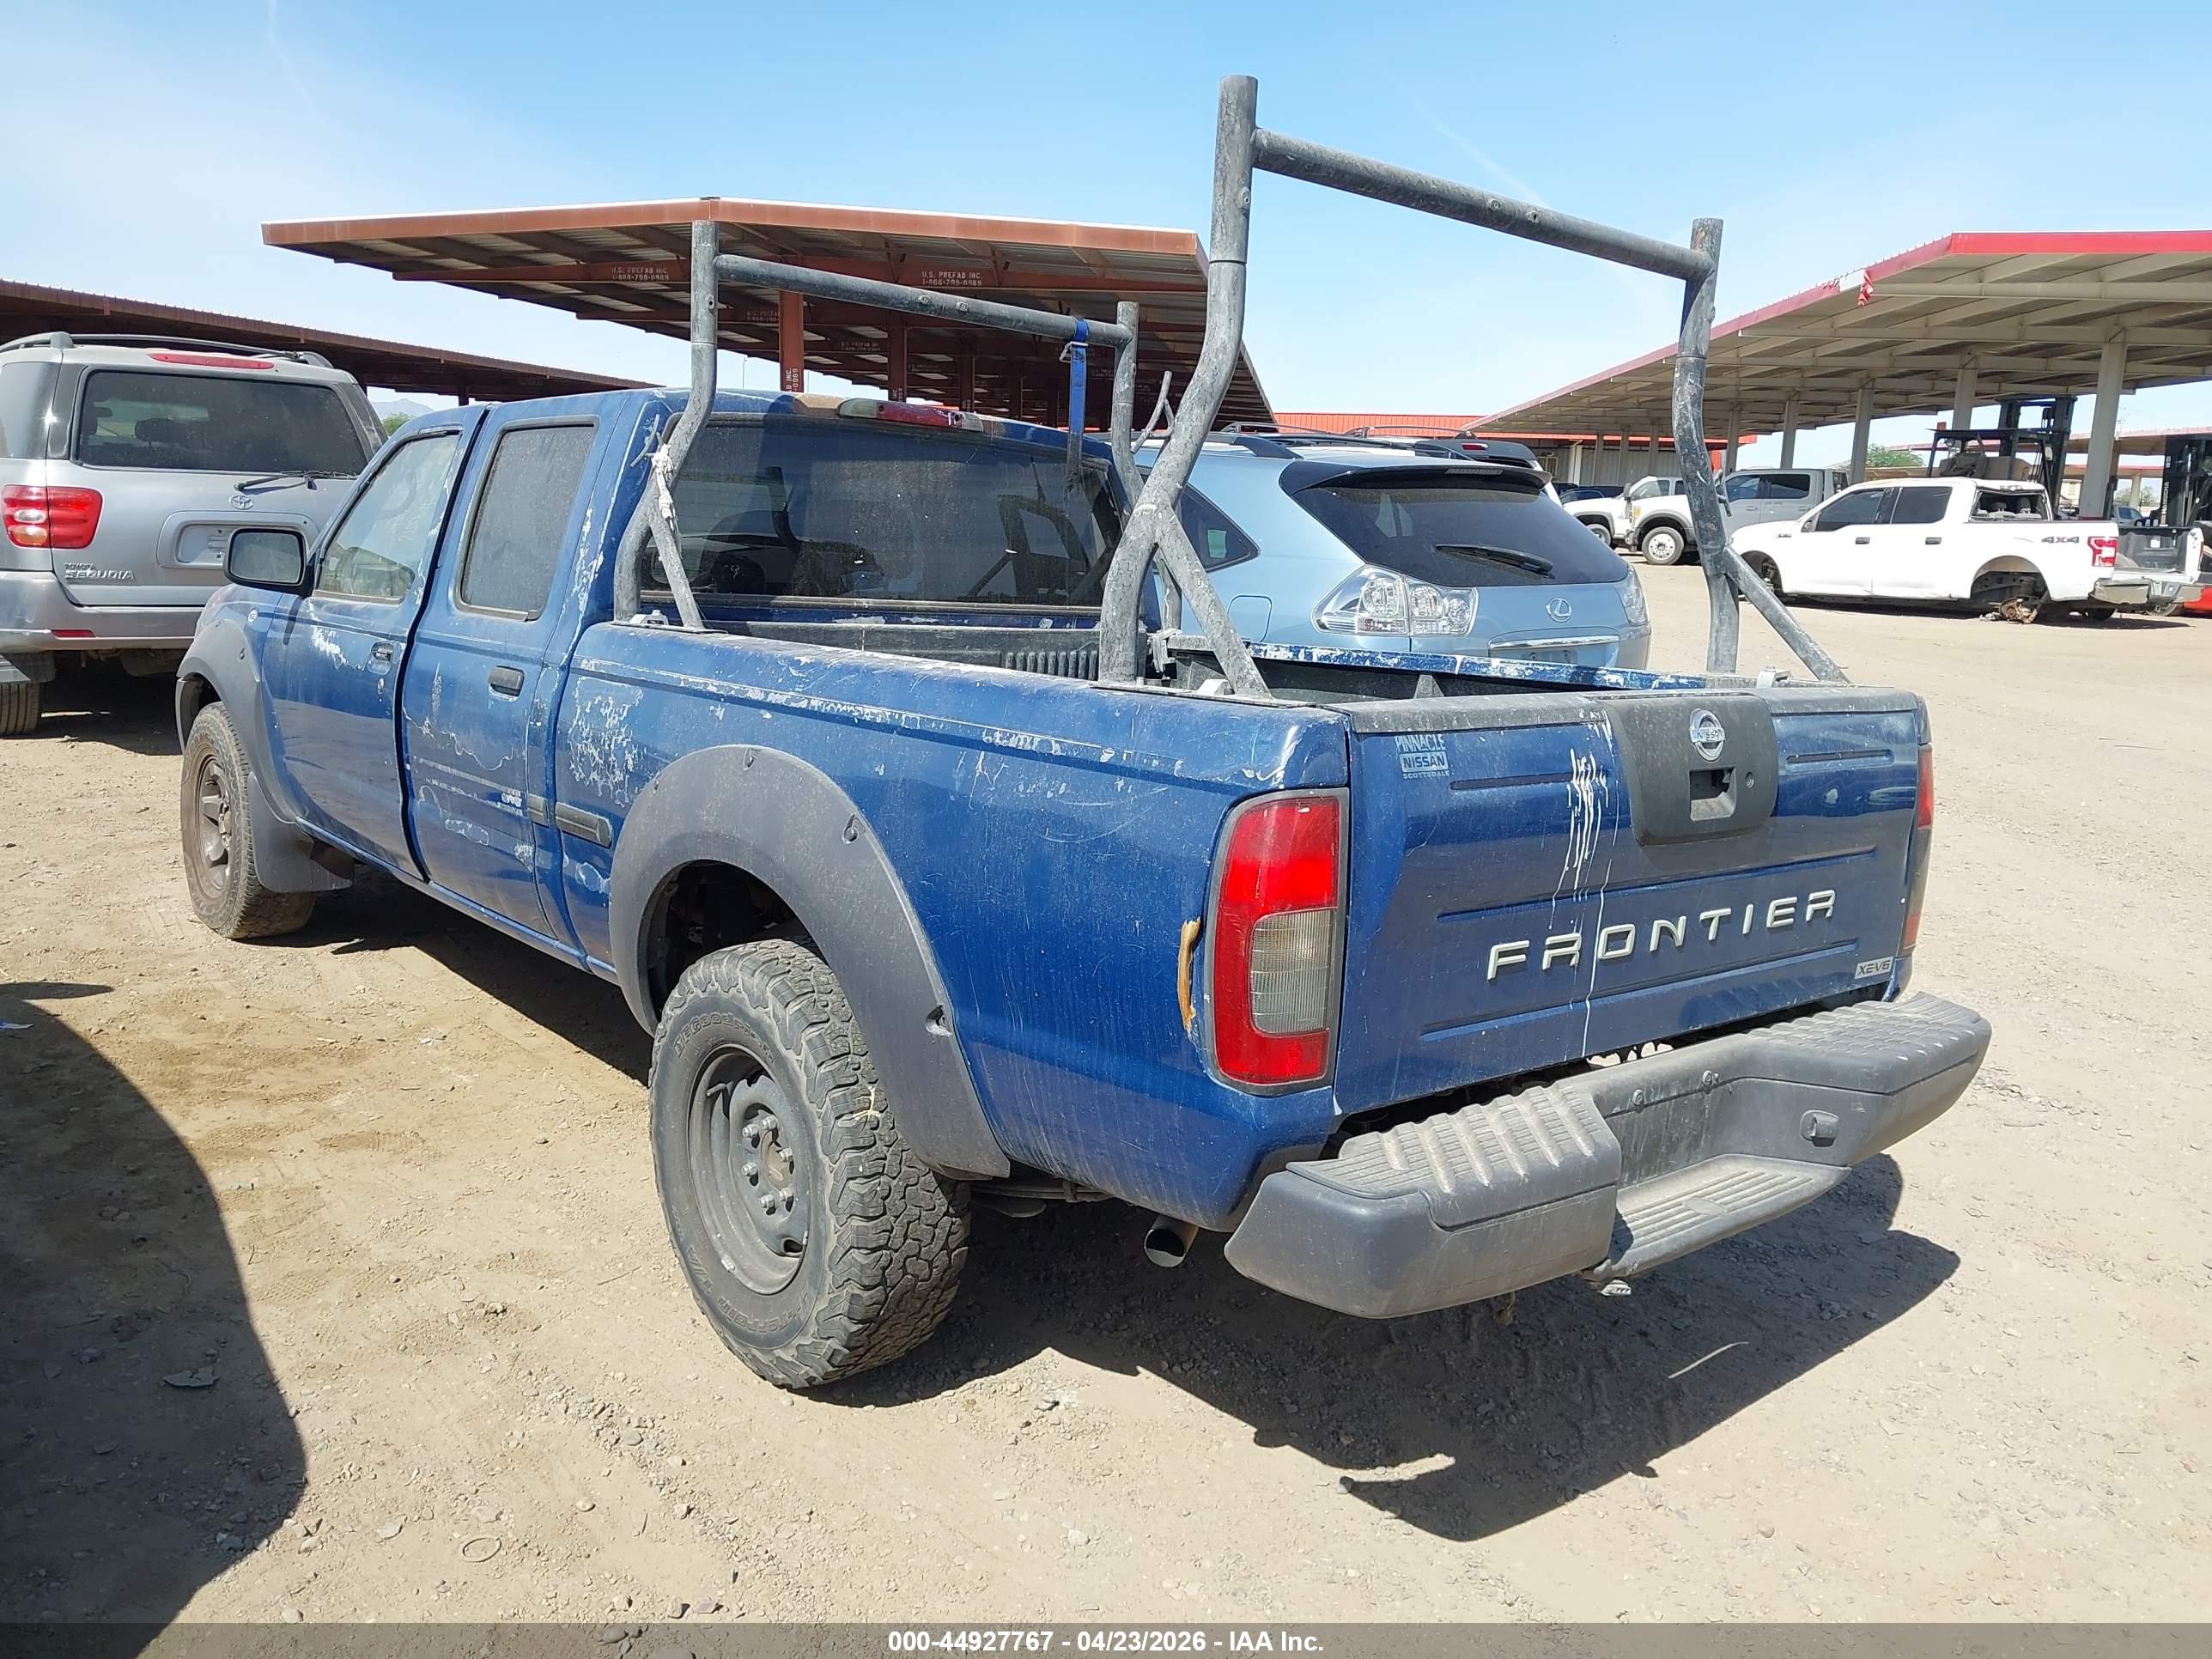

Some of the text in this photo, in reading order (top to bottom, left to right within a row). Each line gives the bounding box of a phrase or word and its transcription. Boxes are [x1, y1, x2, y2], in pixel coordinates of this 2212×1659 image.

[64, 569, 135, 580] SEQUOIA
[1395, 734, 1445, 751] PINNACLE
[1402, 755, 1445, 769] NISSAN
[1486, 889, 1836, 981] FRONTIER
